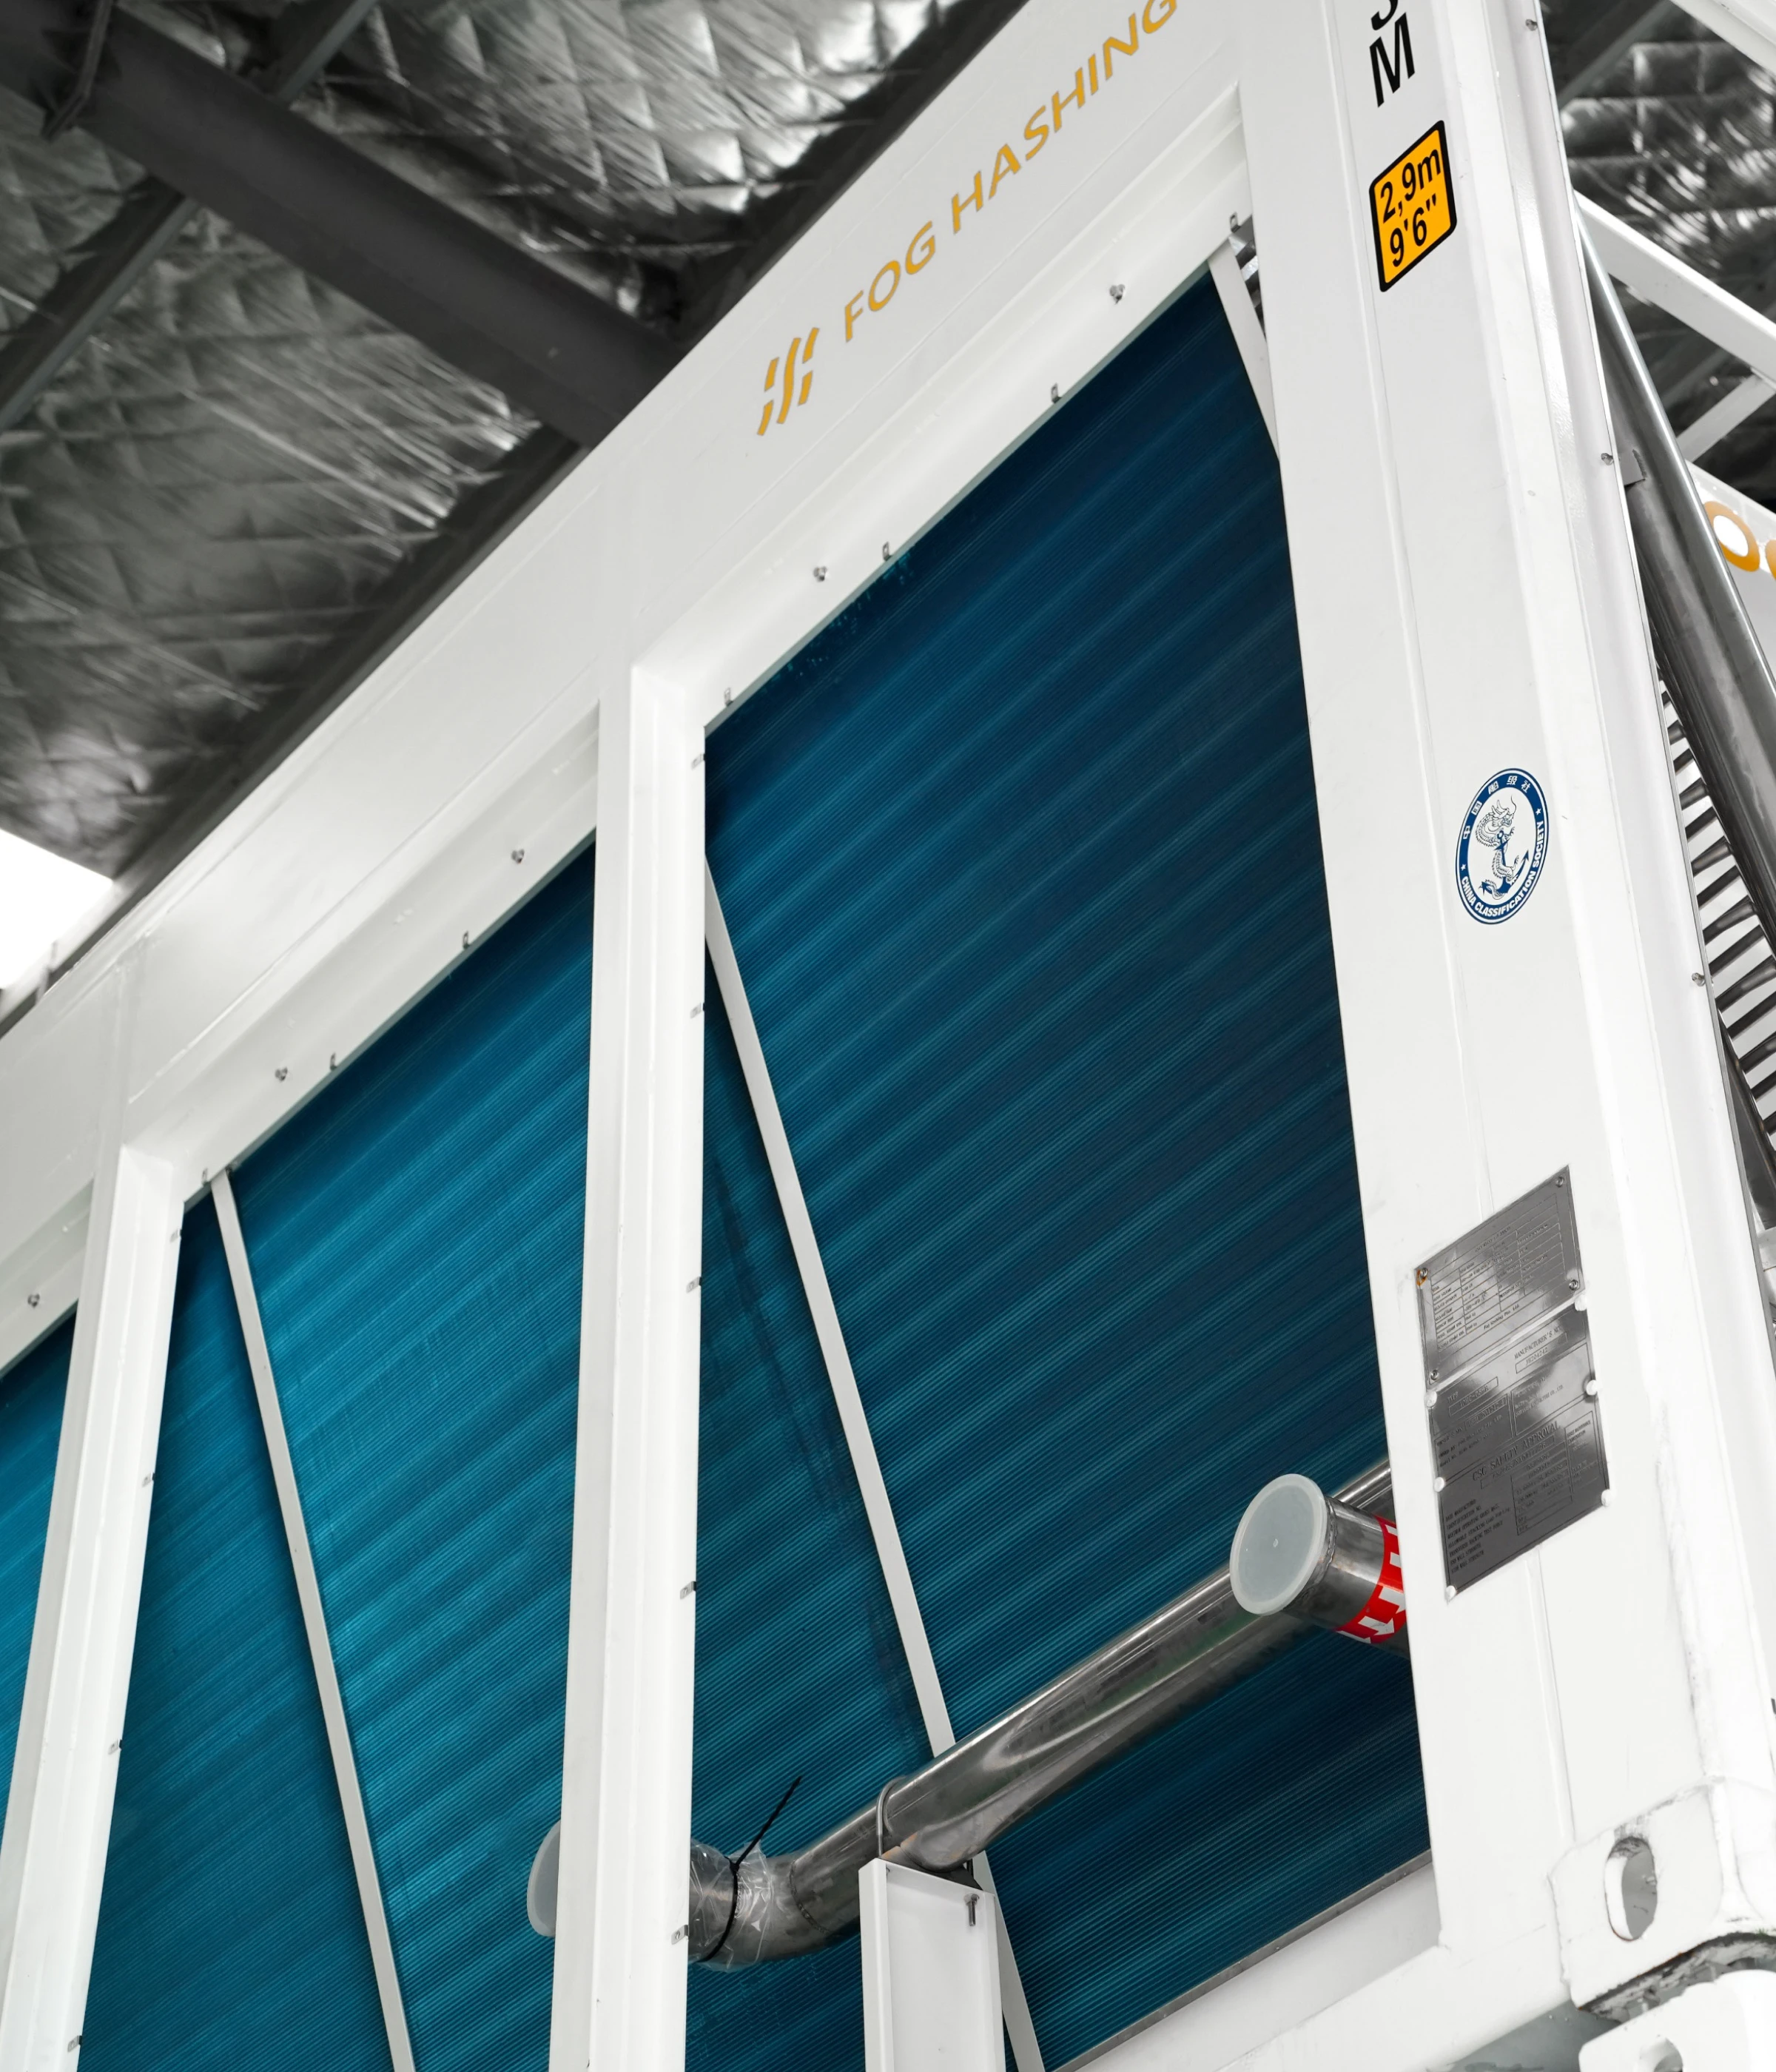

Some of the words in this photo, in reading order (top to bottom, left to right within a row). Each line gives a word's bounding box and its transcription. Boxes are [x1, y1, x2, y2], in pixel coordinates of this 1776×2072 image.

[845, 222, 935, 340] FOG
[952, 0, 1177, 232] HASHING
[1380, 149, 1441, 223] 2,9m
[1461, 875, 1477, 906] CHINA
[1474, 870, 1537, 917] CLASSIFICATION
[1533, 821, 1544, 868] SOCIETY
[1473, 1465, 1487, 1481] CSC
[1490, 1445, 1518, 1470] SAFETY
[1523, 1420, 1559, 1448] APPROVAL
